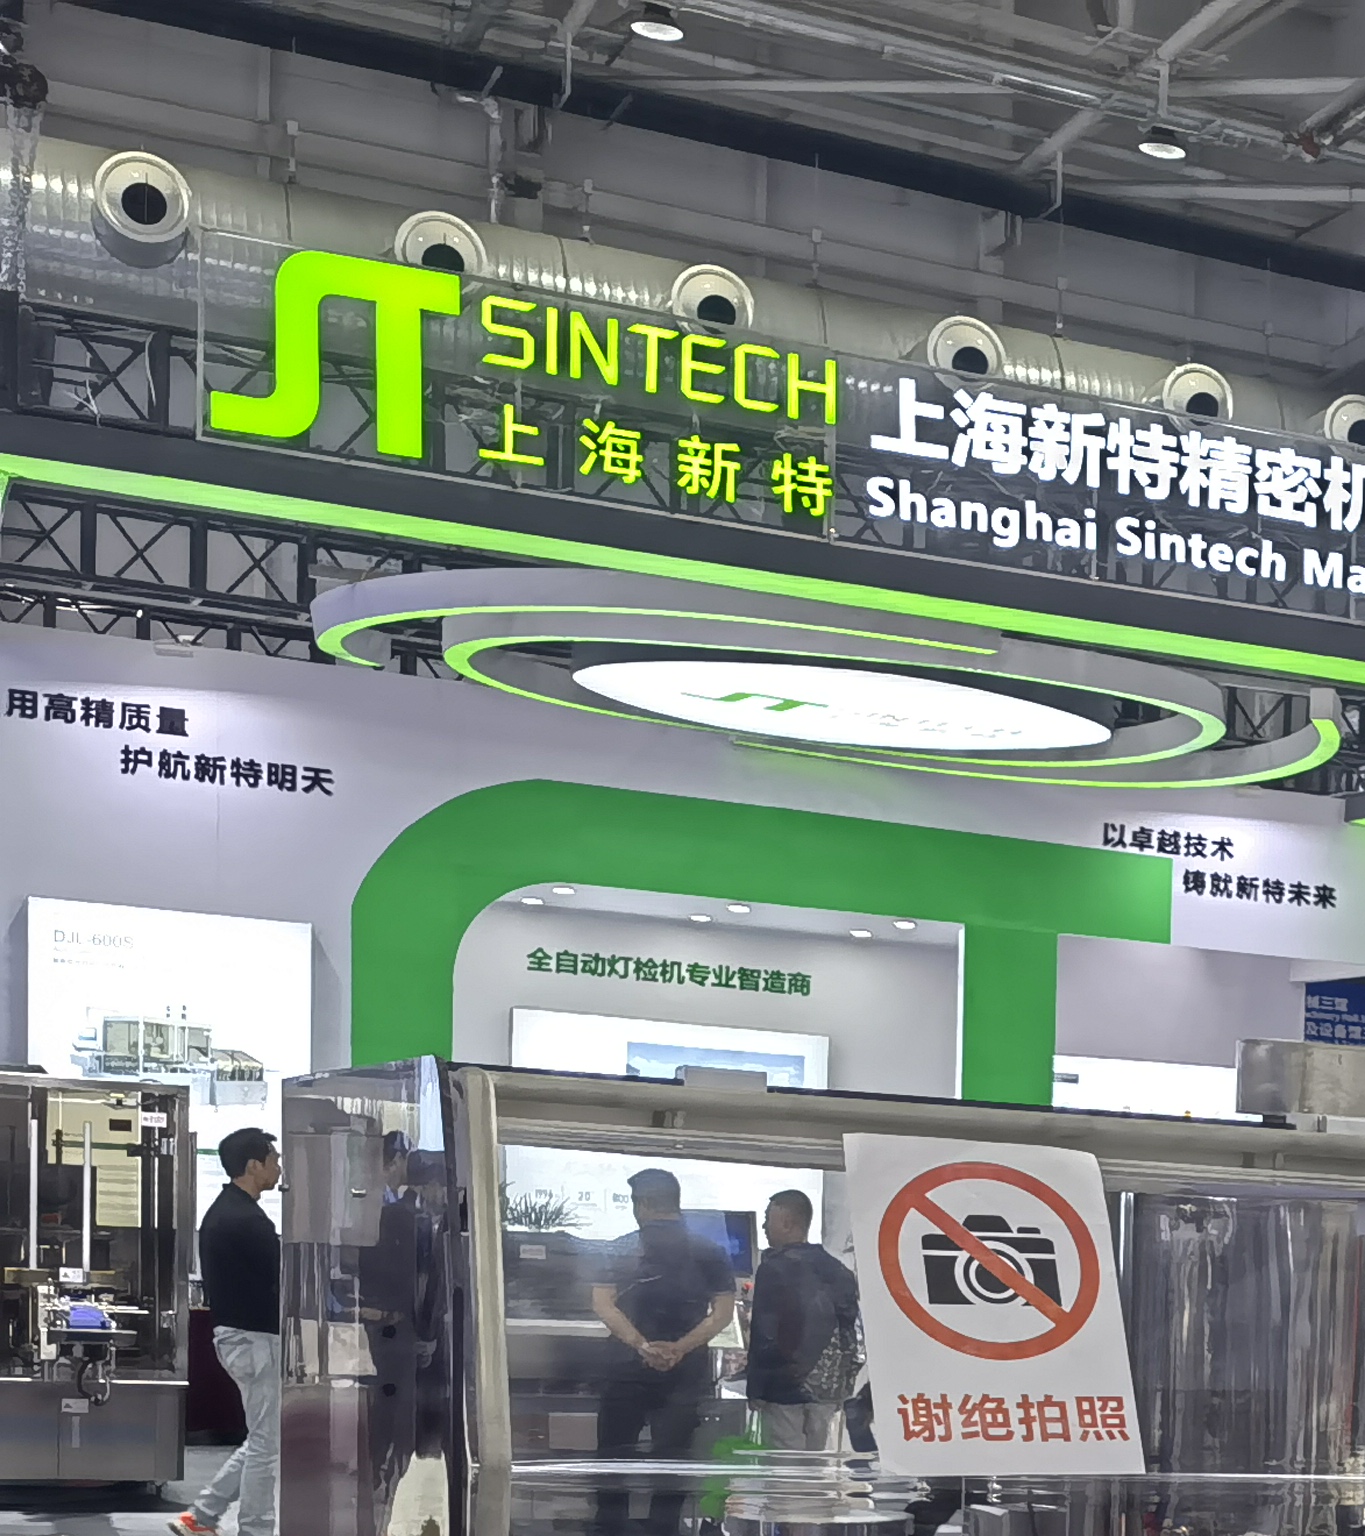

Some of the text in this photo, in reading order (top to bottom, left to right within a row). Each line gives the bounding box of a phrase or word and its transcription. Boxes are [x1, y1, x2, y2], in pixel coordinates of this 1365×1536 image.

[480, 295, 838, 425] SINTECH
[478, 404, 834, 518] 上海新特
[865, 475, 1098, 550] Shanghai
[1115, 515, 1288, 582] Sintech
[4, 688, 189, 737] 用高精质量
[120, 745, 335, 797] 护航新特明天
[1102, 822, 1235, 862] 以卓越技术
[1182, 868, 1337, 909] 铸就新特未来
[526, 947, 812, 997] 全自动灯检机专业智造商
[897, 1393, 1130, 1442] 谢绝拍照
